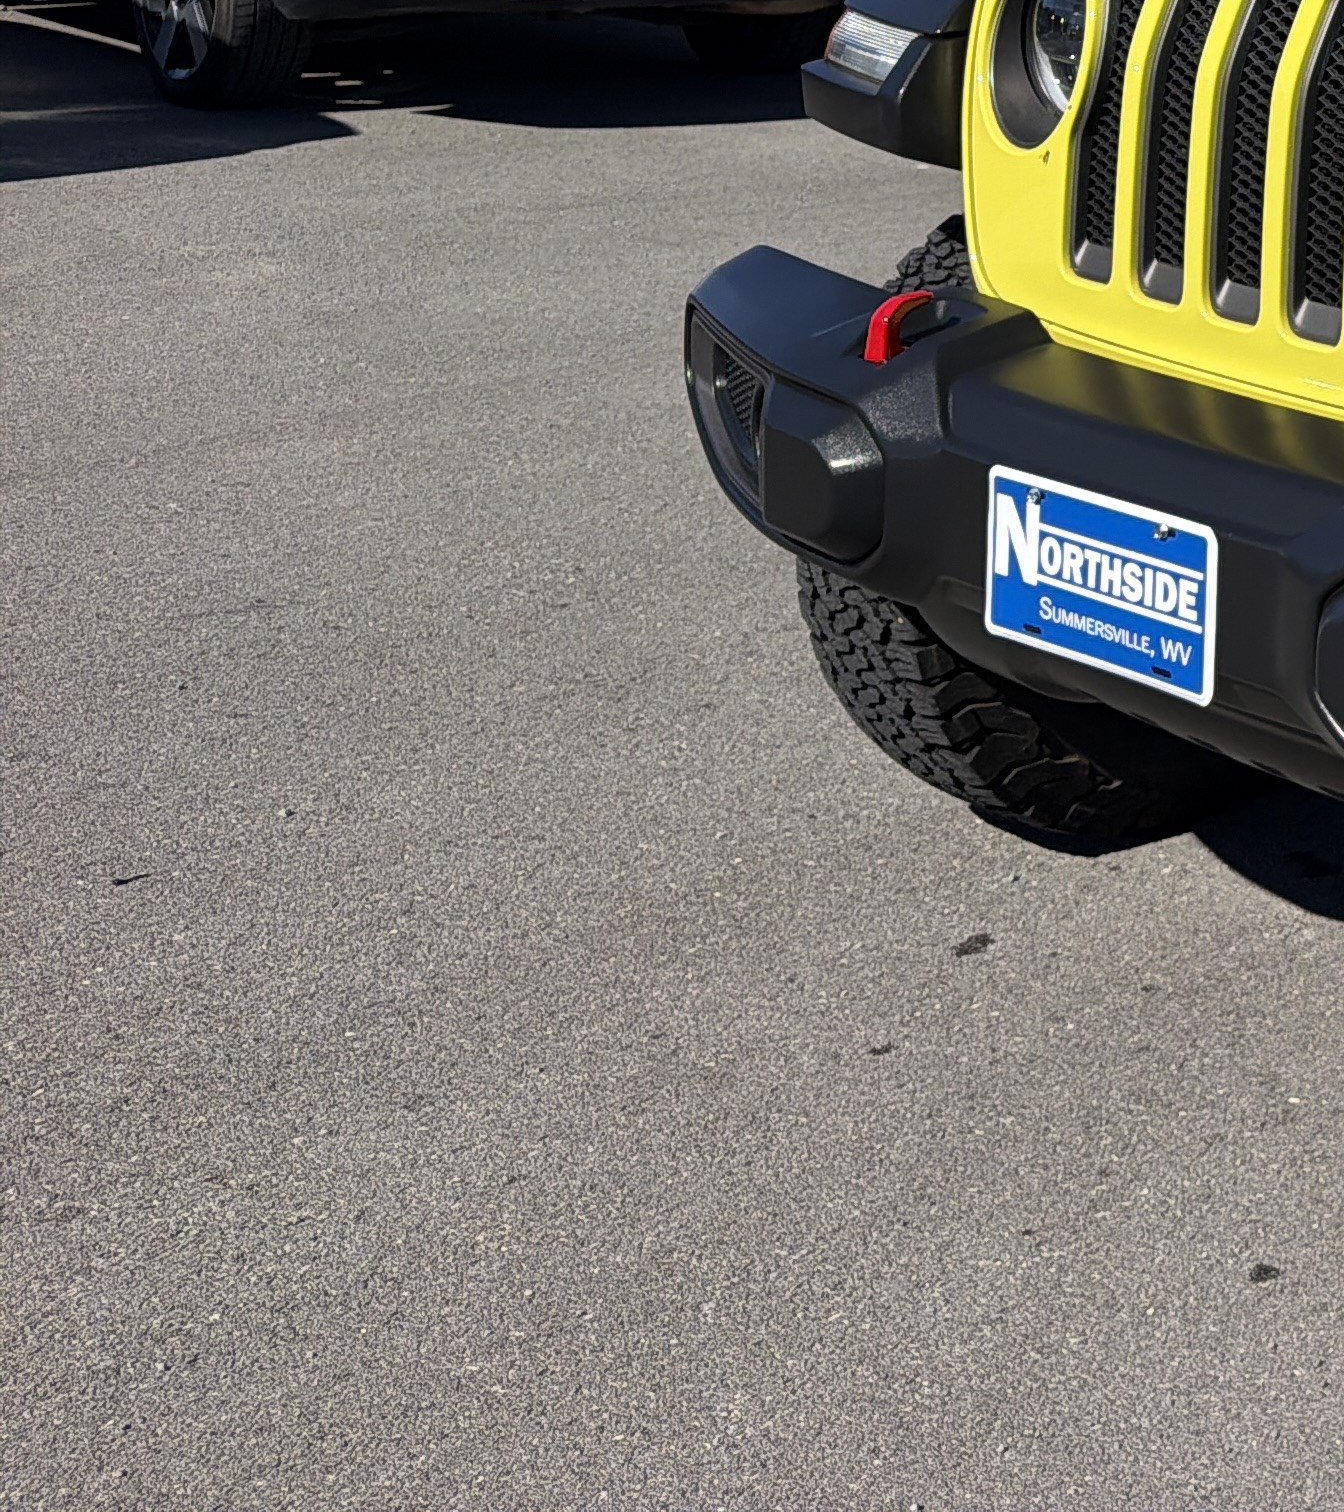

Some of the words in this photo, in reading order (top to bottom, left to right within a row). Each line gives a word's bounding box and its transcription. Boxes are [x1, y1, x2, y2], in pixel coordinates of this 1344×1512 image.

[995, 492, 1199, 622] NORTHSIDE
[1039, 596, 1155, 658] SUMMERSVILLE,
[1160, 636, 1192, 666] WV
